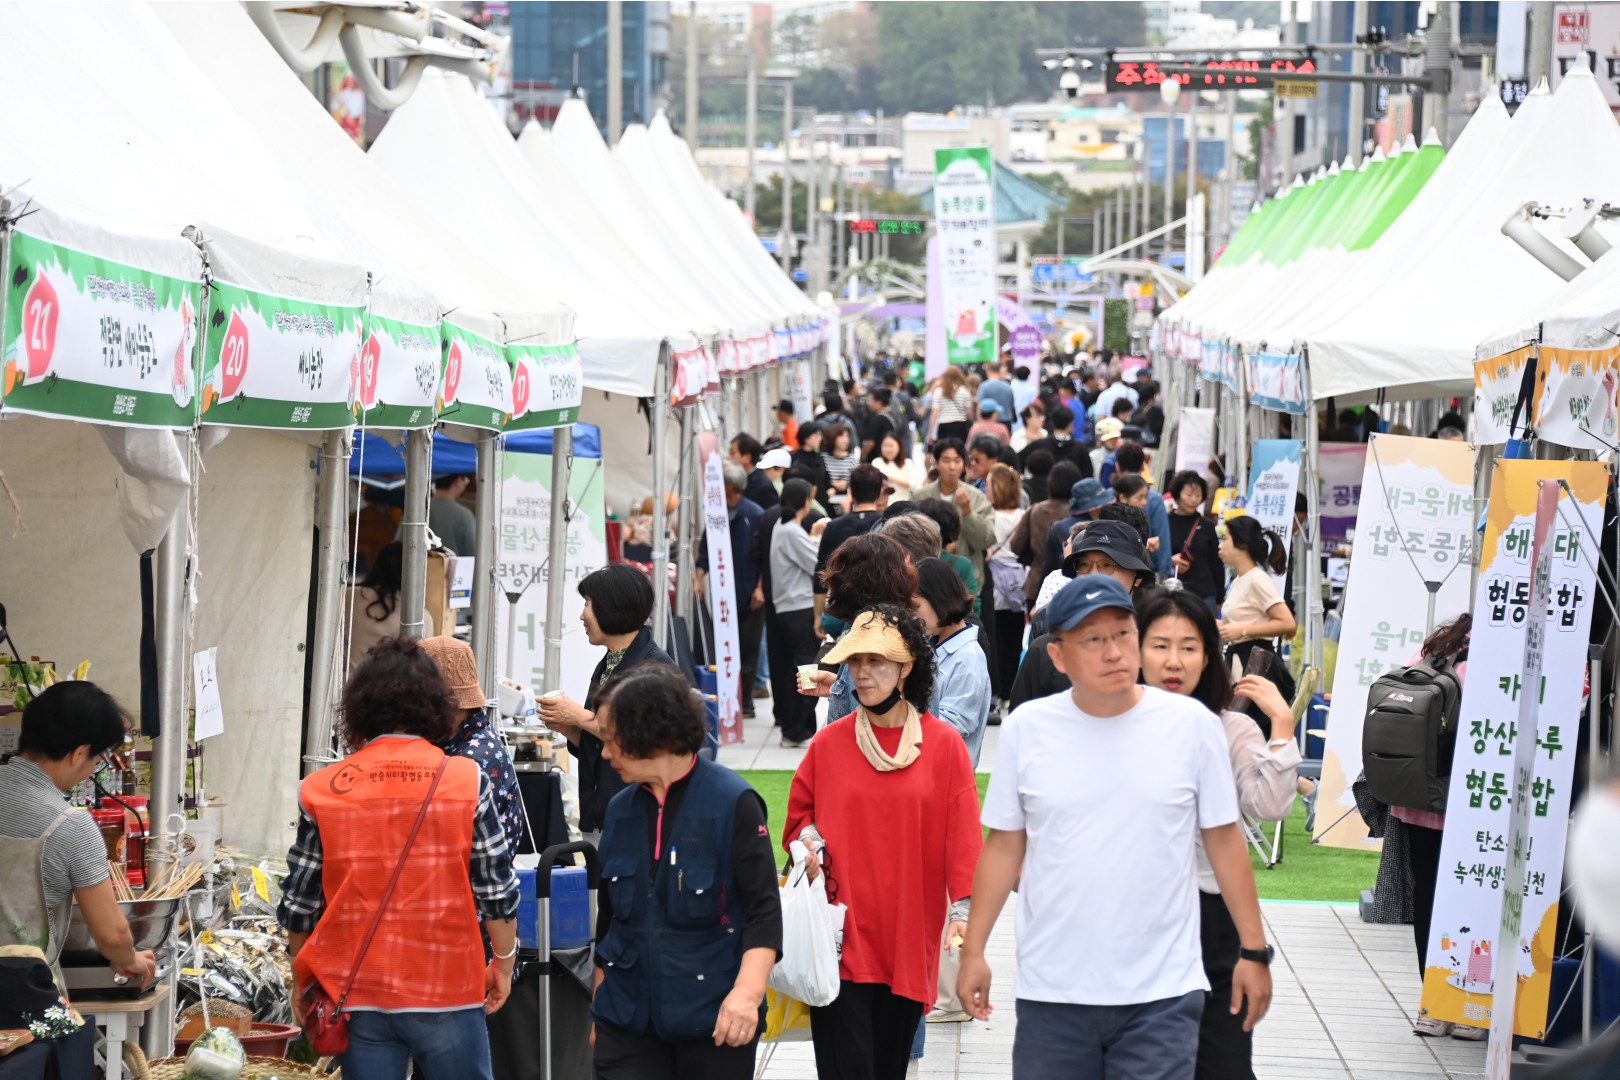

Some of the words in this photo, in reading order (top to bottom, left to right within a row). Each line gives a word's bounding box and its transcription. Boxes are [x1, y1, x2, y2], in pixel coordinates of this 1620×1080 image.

[29, 299, 50, 352] 21
[225, 334, 246, 377] 20
[298, 347, 324, 390] 써니농장
[362, 353, 375, 387] 19
[448, 357, 458, 388] 18
[517, 375, 527, 402] 17
[1505, 526, 1581, 561] 해대
[1488, 580, 1584, 627] 협동합
[1499, 674, 1546, 705] 카
[1470, 718, 1563, 760] 장산루
[1466, 769, 1555, 817] 협동합
[1476, 830, 1534, 862] 탄소
[1453, 860, 1506, 890] 녹색생
